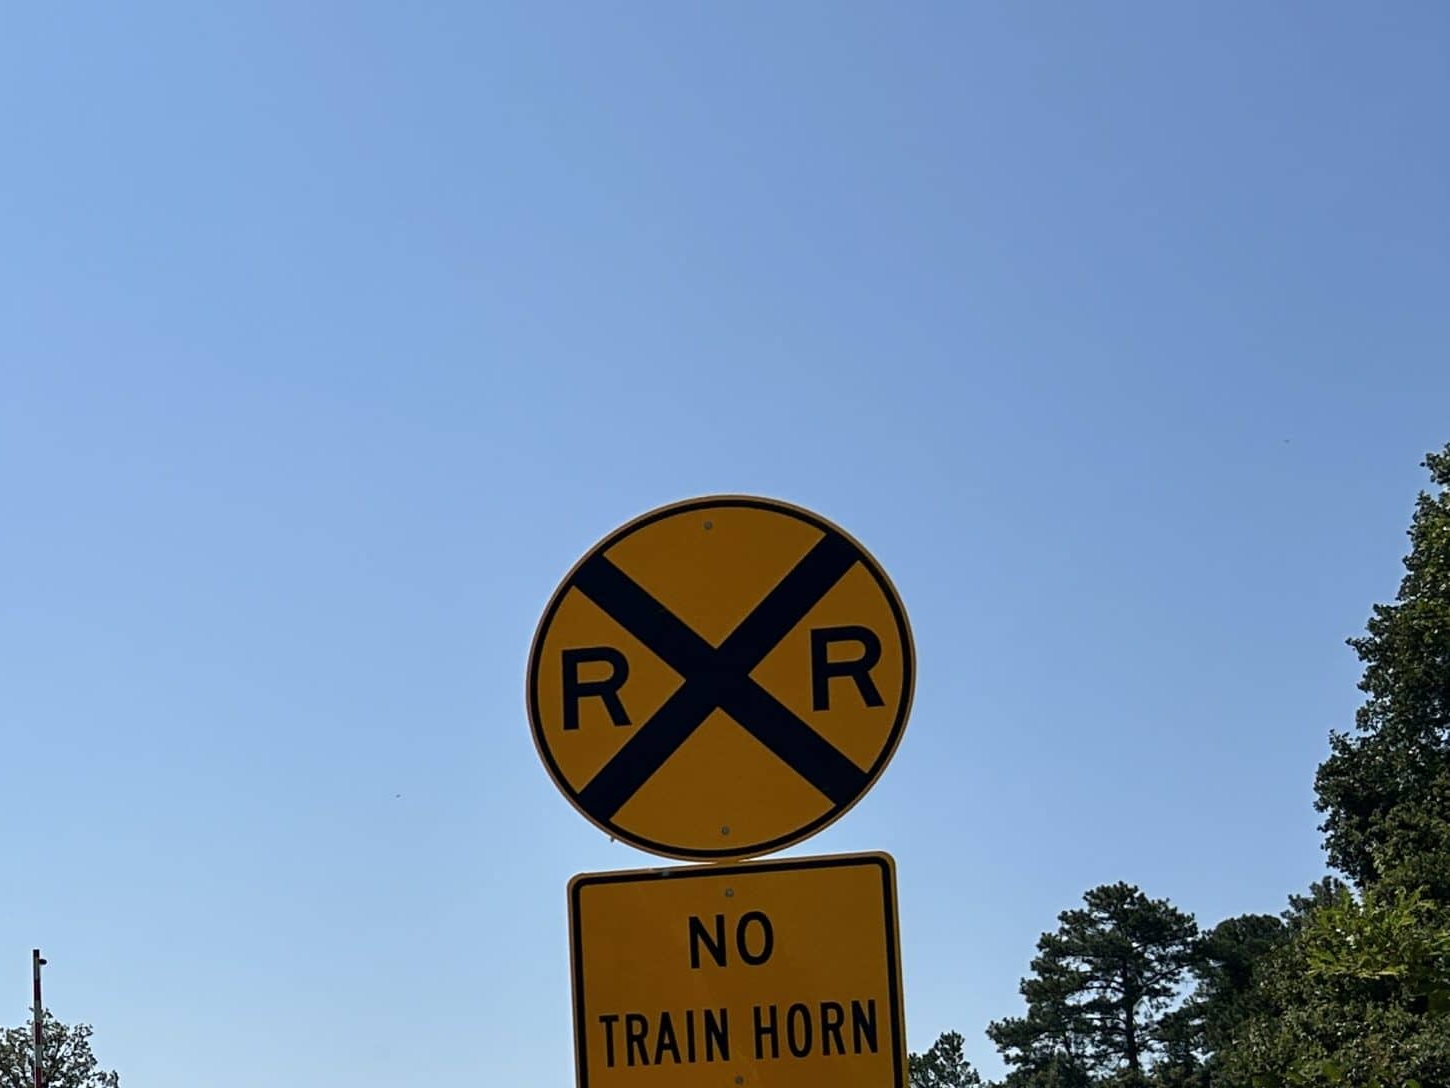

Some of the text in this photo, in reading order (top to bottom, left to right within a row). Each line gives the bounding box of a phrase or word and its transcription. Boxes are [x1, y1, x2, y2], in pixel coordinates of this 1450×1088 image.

[560, 624, 886, 730] R R
[688, 910, 773, 969] NO
[598, 999, 879, 1068] TRAIN HORN
